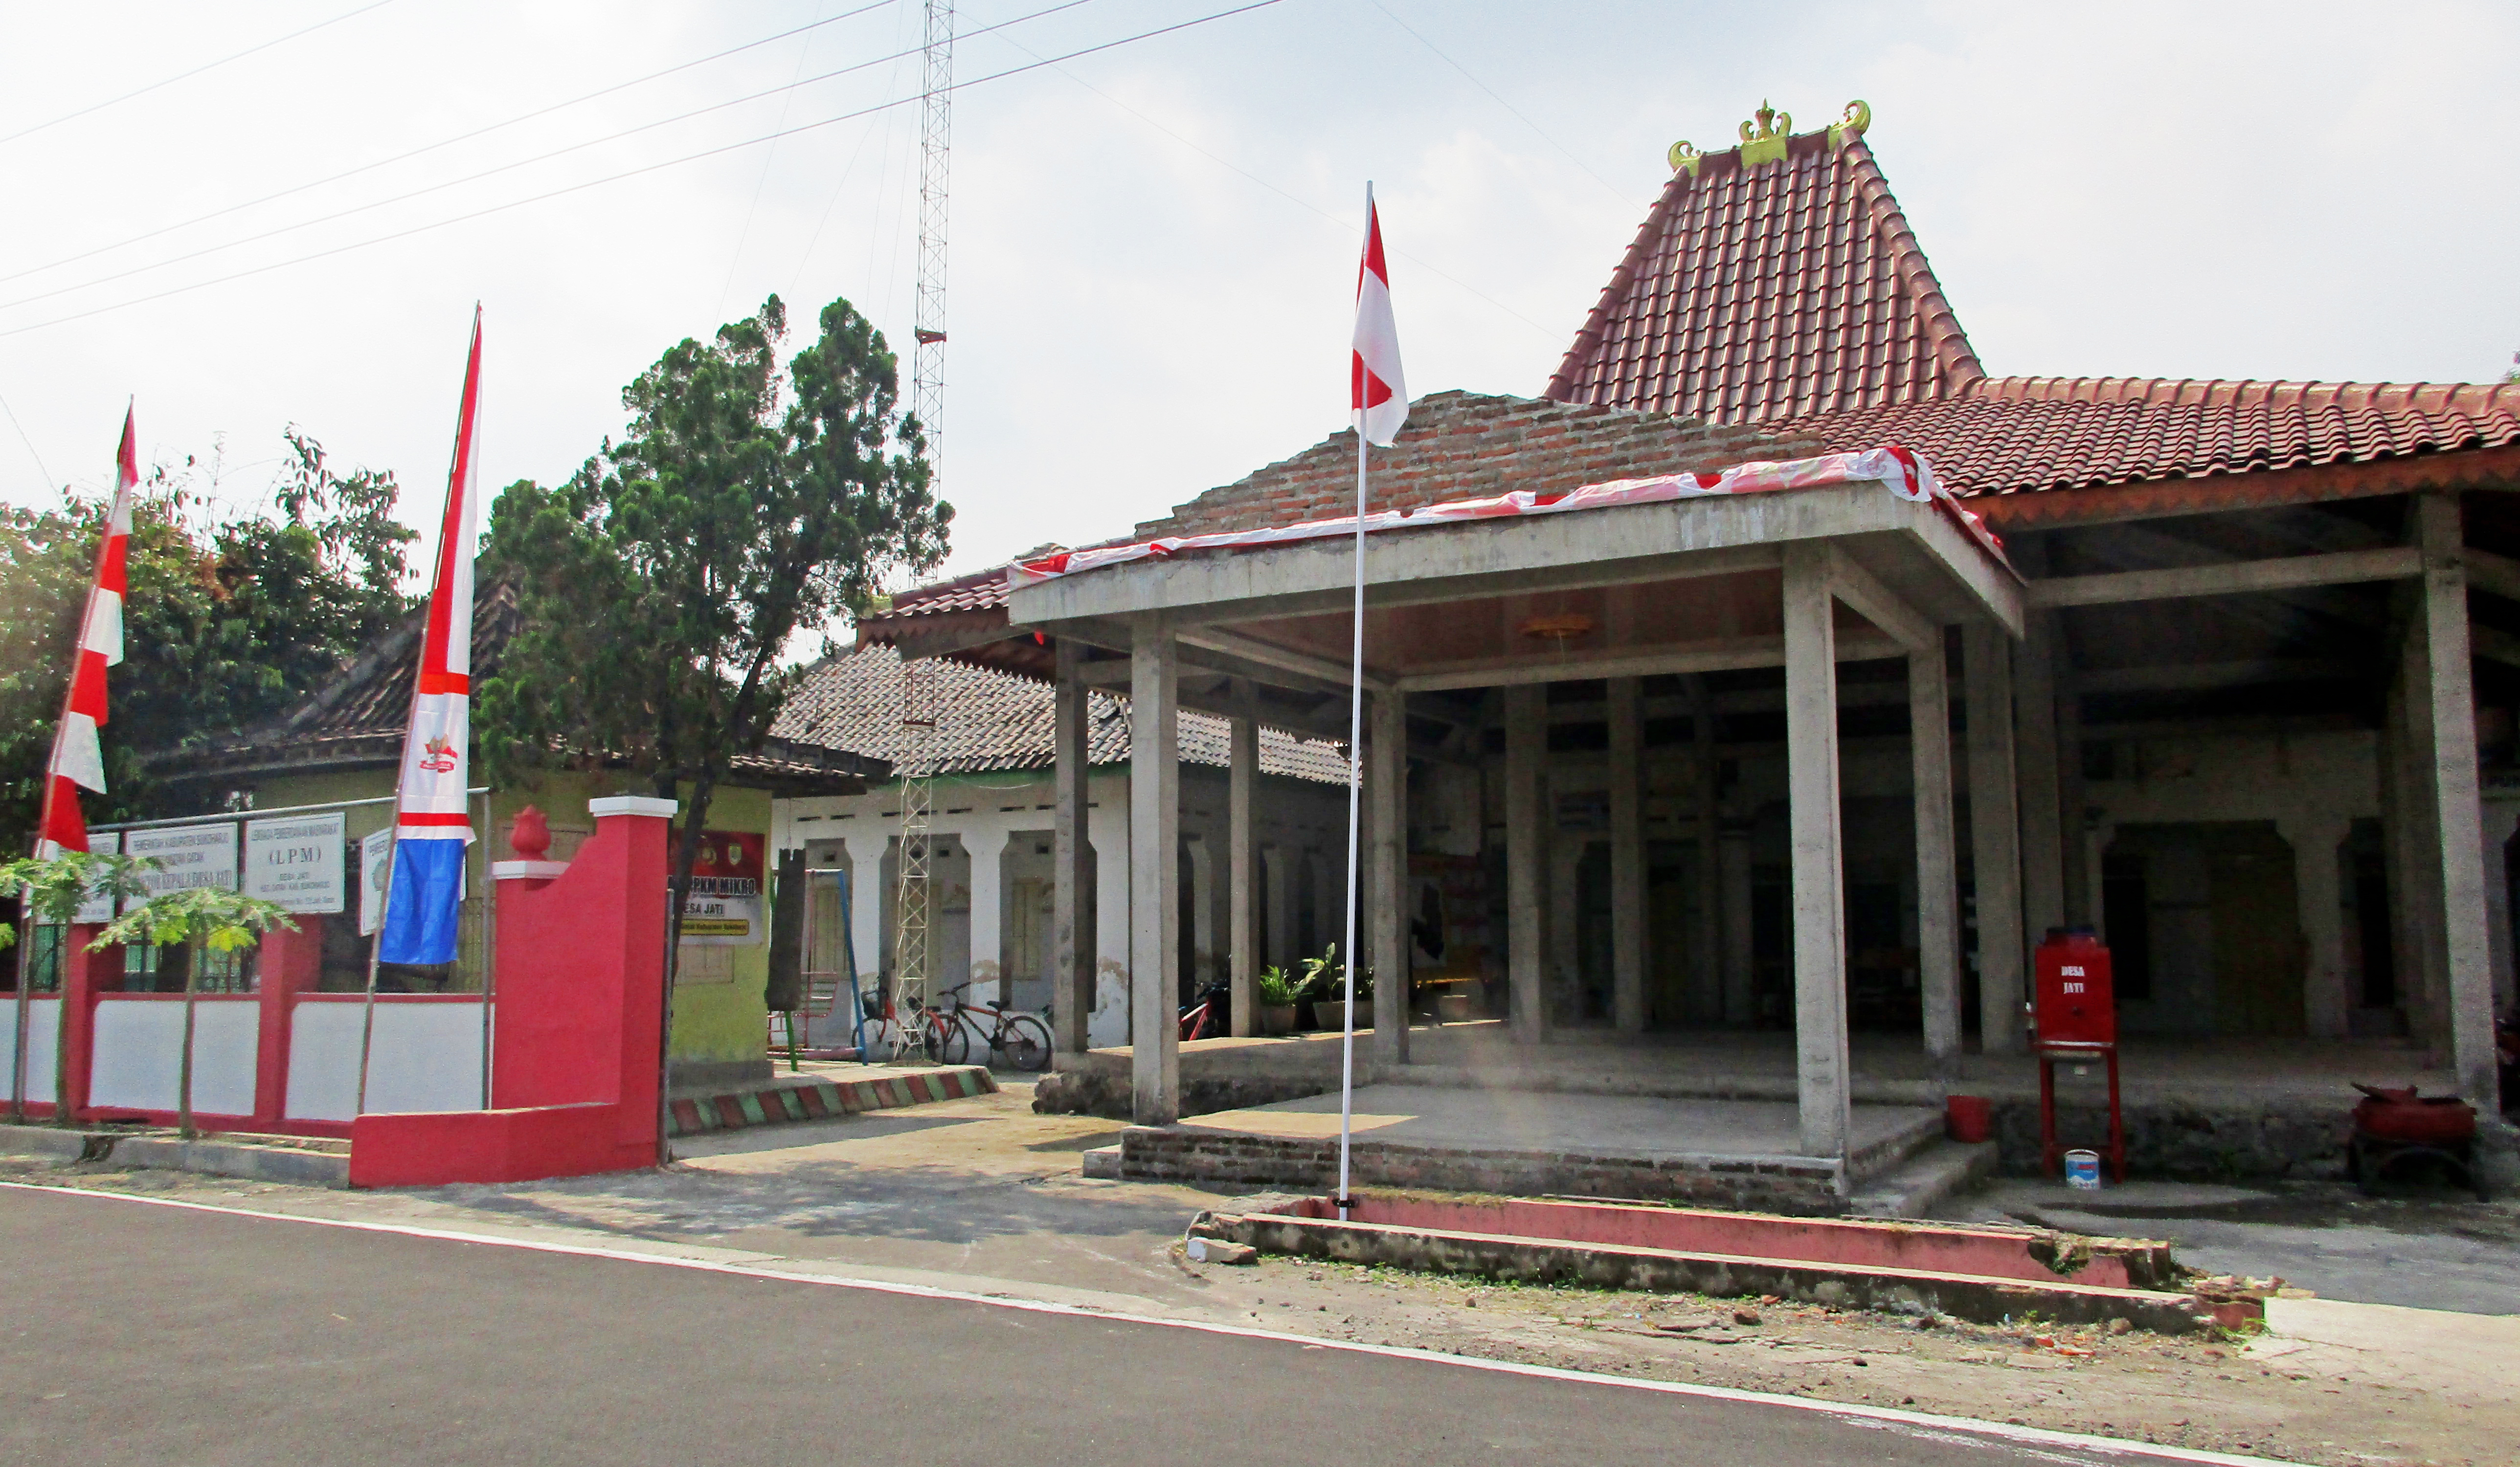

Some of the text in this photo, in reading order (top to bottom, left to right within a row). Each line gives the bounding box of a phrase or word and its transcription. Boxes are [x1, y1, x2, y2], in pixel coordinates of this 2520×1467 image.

[691, 876, 718, 895] PKM
[719, 877, 756, 895] MIKRO
[684, 903, 724, 915] ESA JATI
[2061, 965, 2085, 977] DESA
[2063, 982, 2084, 994] JATI
